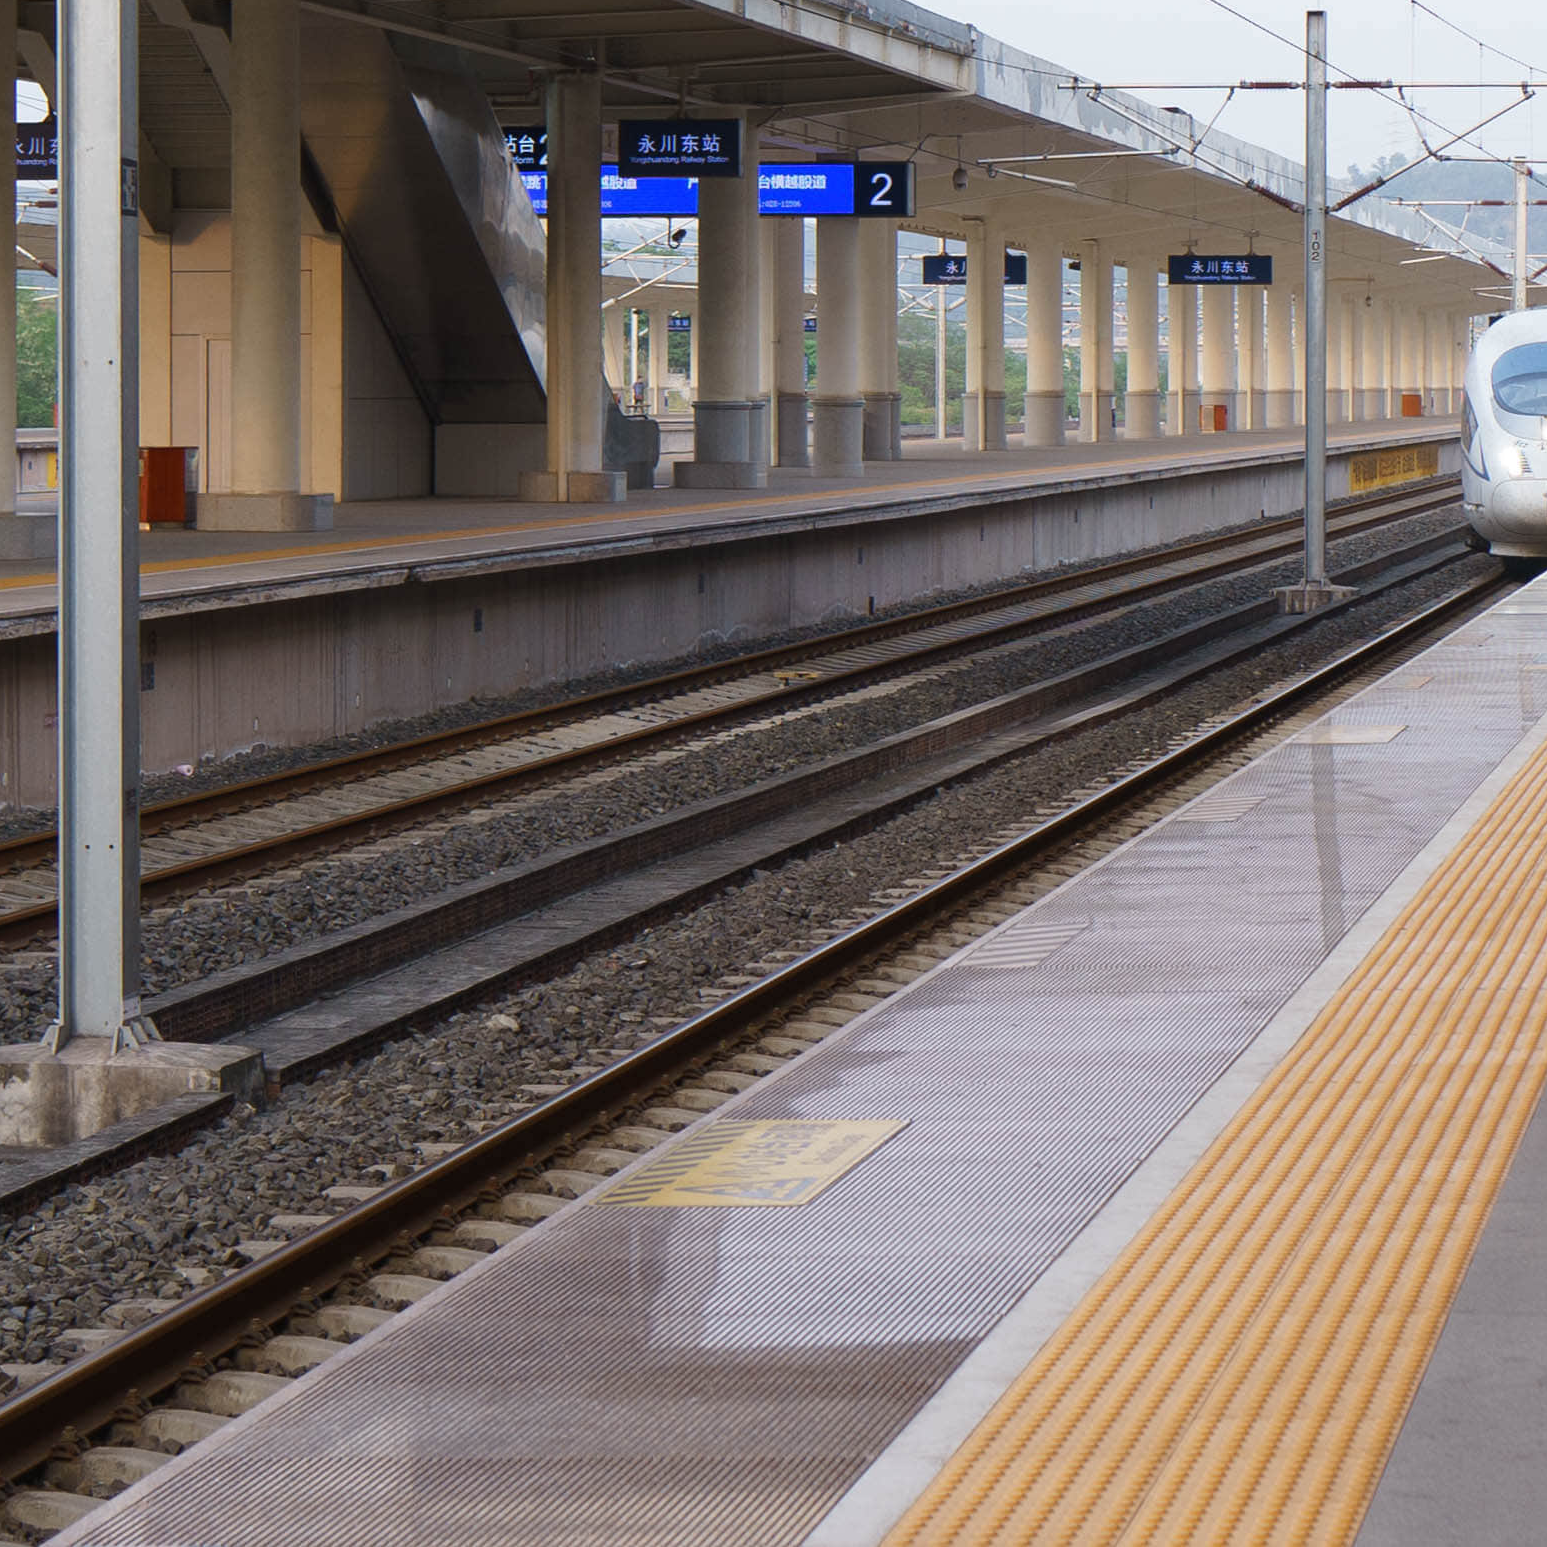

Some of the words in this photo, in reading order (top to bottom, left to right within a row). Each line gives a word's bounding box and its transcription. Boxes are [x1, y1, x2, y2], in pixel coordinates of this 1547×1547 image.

[638, 134, 721, 154] 永川东站
[870, 173, 893, 206] 2
[1311, 231, 1321, 262] 102
[1191, 260, 1250, 274] 永川东站
